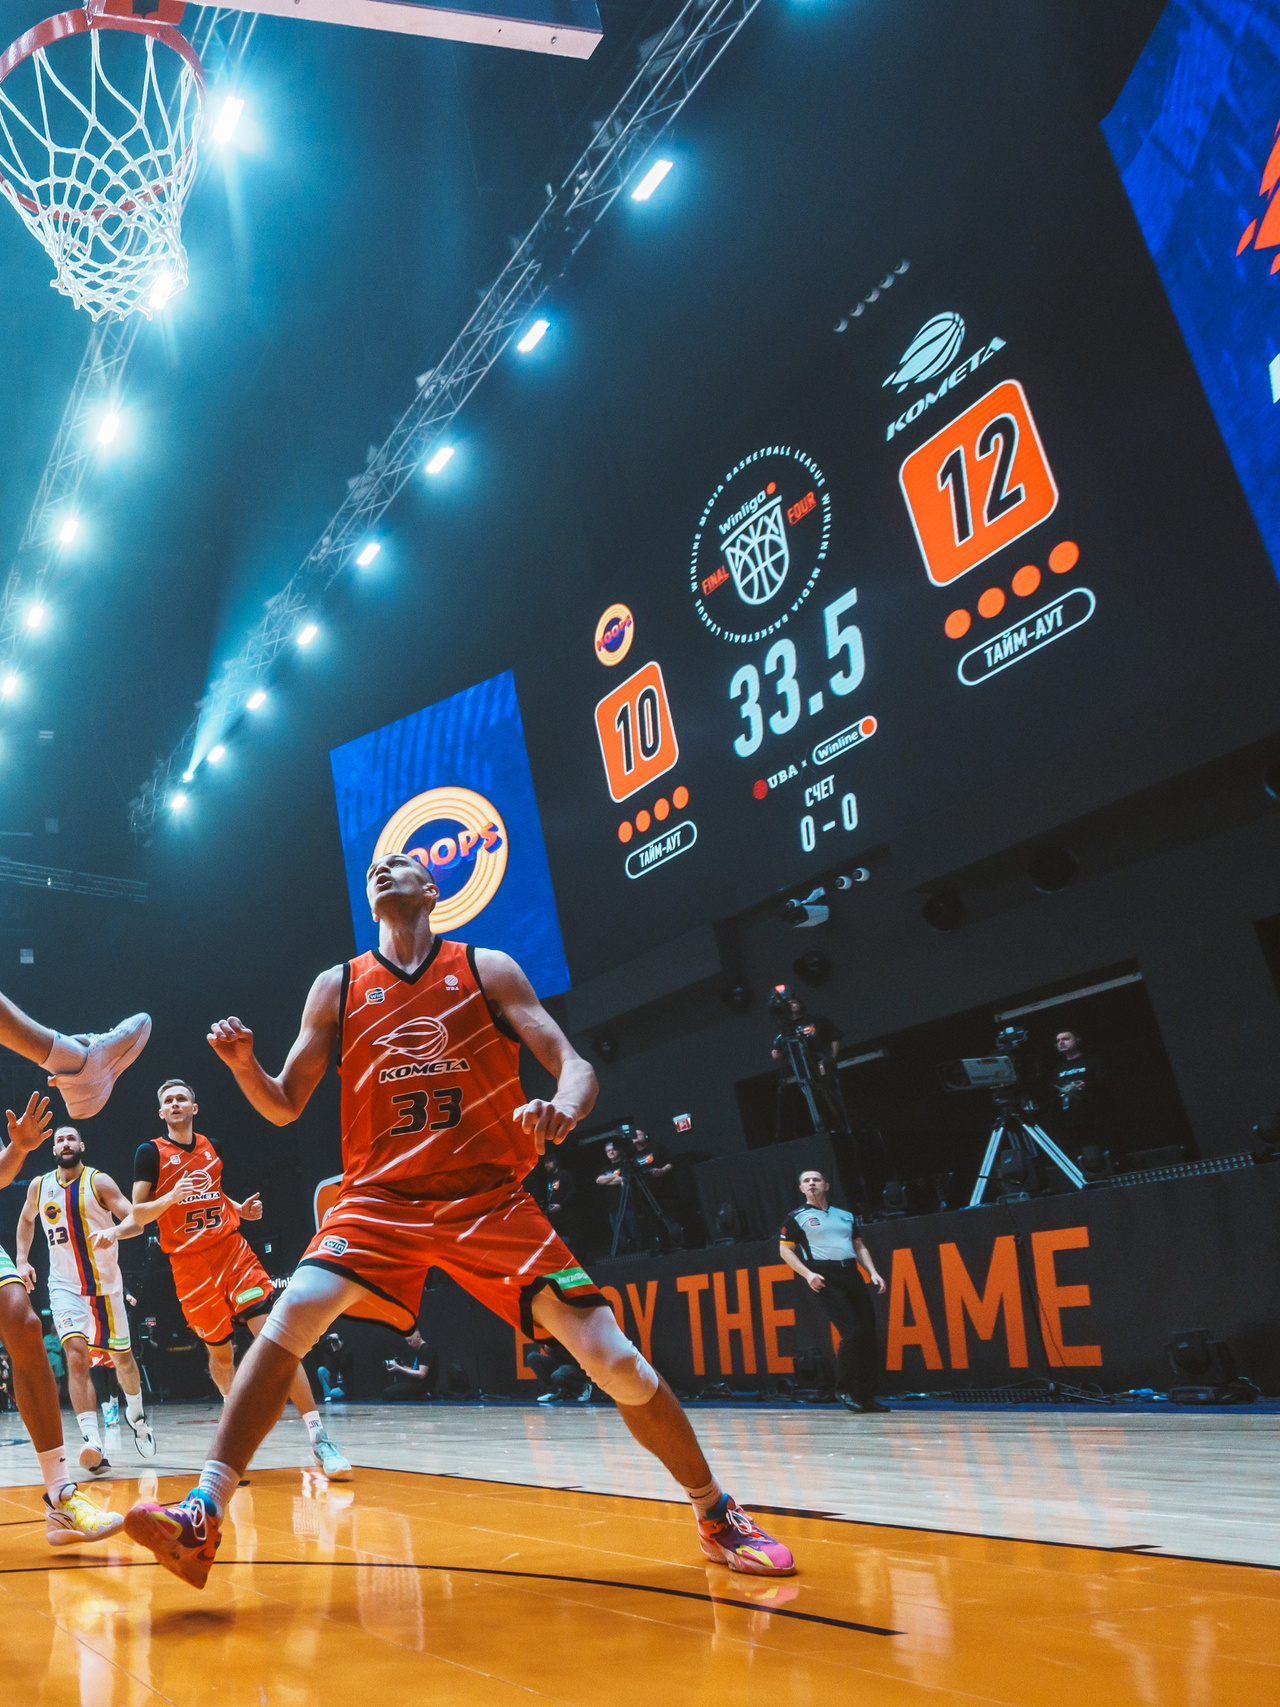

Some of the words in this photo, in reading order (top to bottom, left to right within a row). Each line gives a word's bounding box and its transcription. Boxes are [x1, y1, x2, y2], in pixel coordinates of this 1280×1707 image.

[886, 337, 1007, 441] KOMETA
[725, 445, 791, 482] BASKETBALL
[794, 449, 826, 488] LEAGUE
[937, 412, 1026, 547] 12
[718, 490, 766, 535] Winliga
[787, 491, 817, 522] FOUR
[701, 565, 730, 593] FINAL
[984, 605, 1064, 667] ТАЙМ-АУТ
[729, 587, 866, 758] 33.5
[615, 685, 662, 776] 10
[767, 764, 799, 789] UBA
[817, 729, 859, 761] Winline
[805, 774, 835, 807] СЧЕТ
[407, 822, 502, 868] OOPS
[639, 831, 681, 868] ТАЙМ-АУТ
[379, 1058, 470, 1083] KOMETA
[390, 1086, 463, 1136] 33
[48, 1226, 69, 1246] 23
[184, 1207, 222, 1233] 55
[326, 1241, 344, 1251] Win
[676, 1263, 796, 1376] THE
[830, 1227, 1104, 1371] AME
